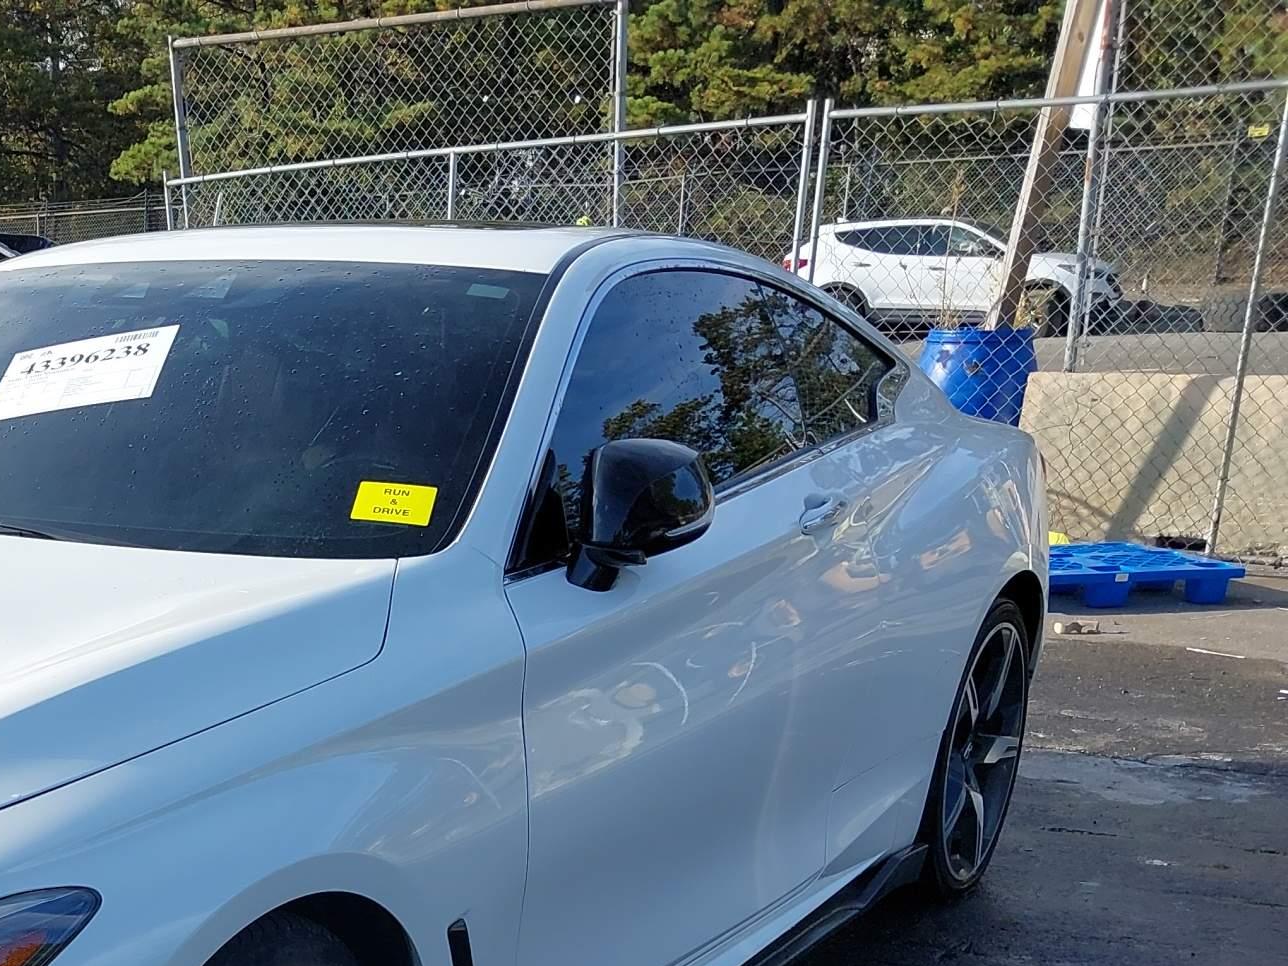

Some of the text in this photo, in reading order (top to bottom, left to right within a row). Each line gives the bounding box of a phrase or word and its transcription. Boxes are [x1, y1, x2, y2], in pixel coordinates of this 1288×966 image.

[20, 342, 151, 375] 43396238
[384, 488, 410, 497] RUN
[373, 506, 411, 517] DRIVE
